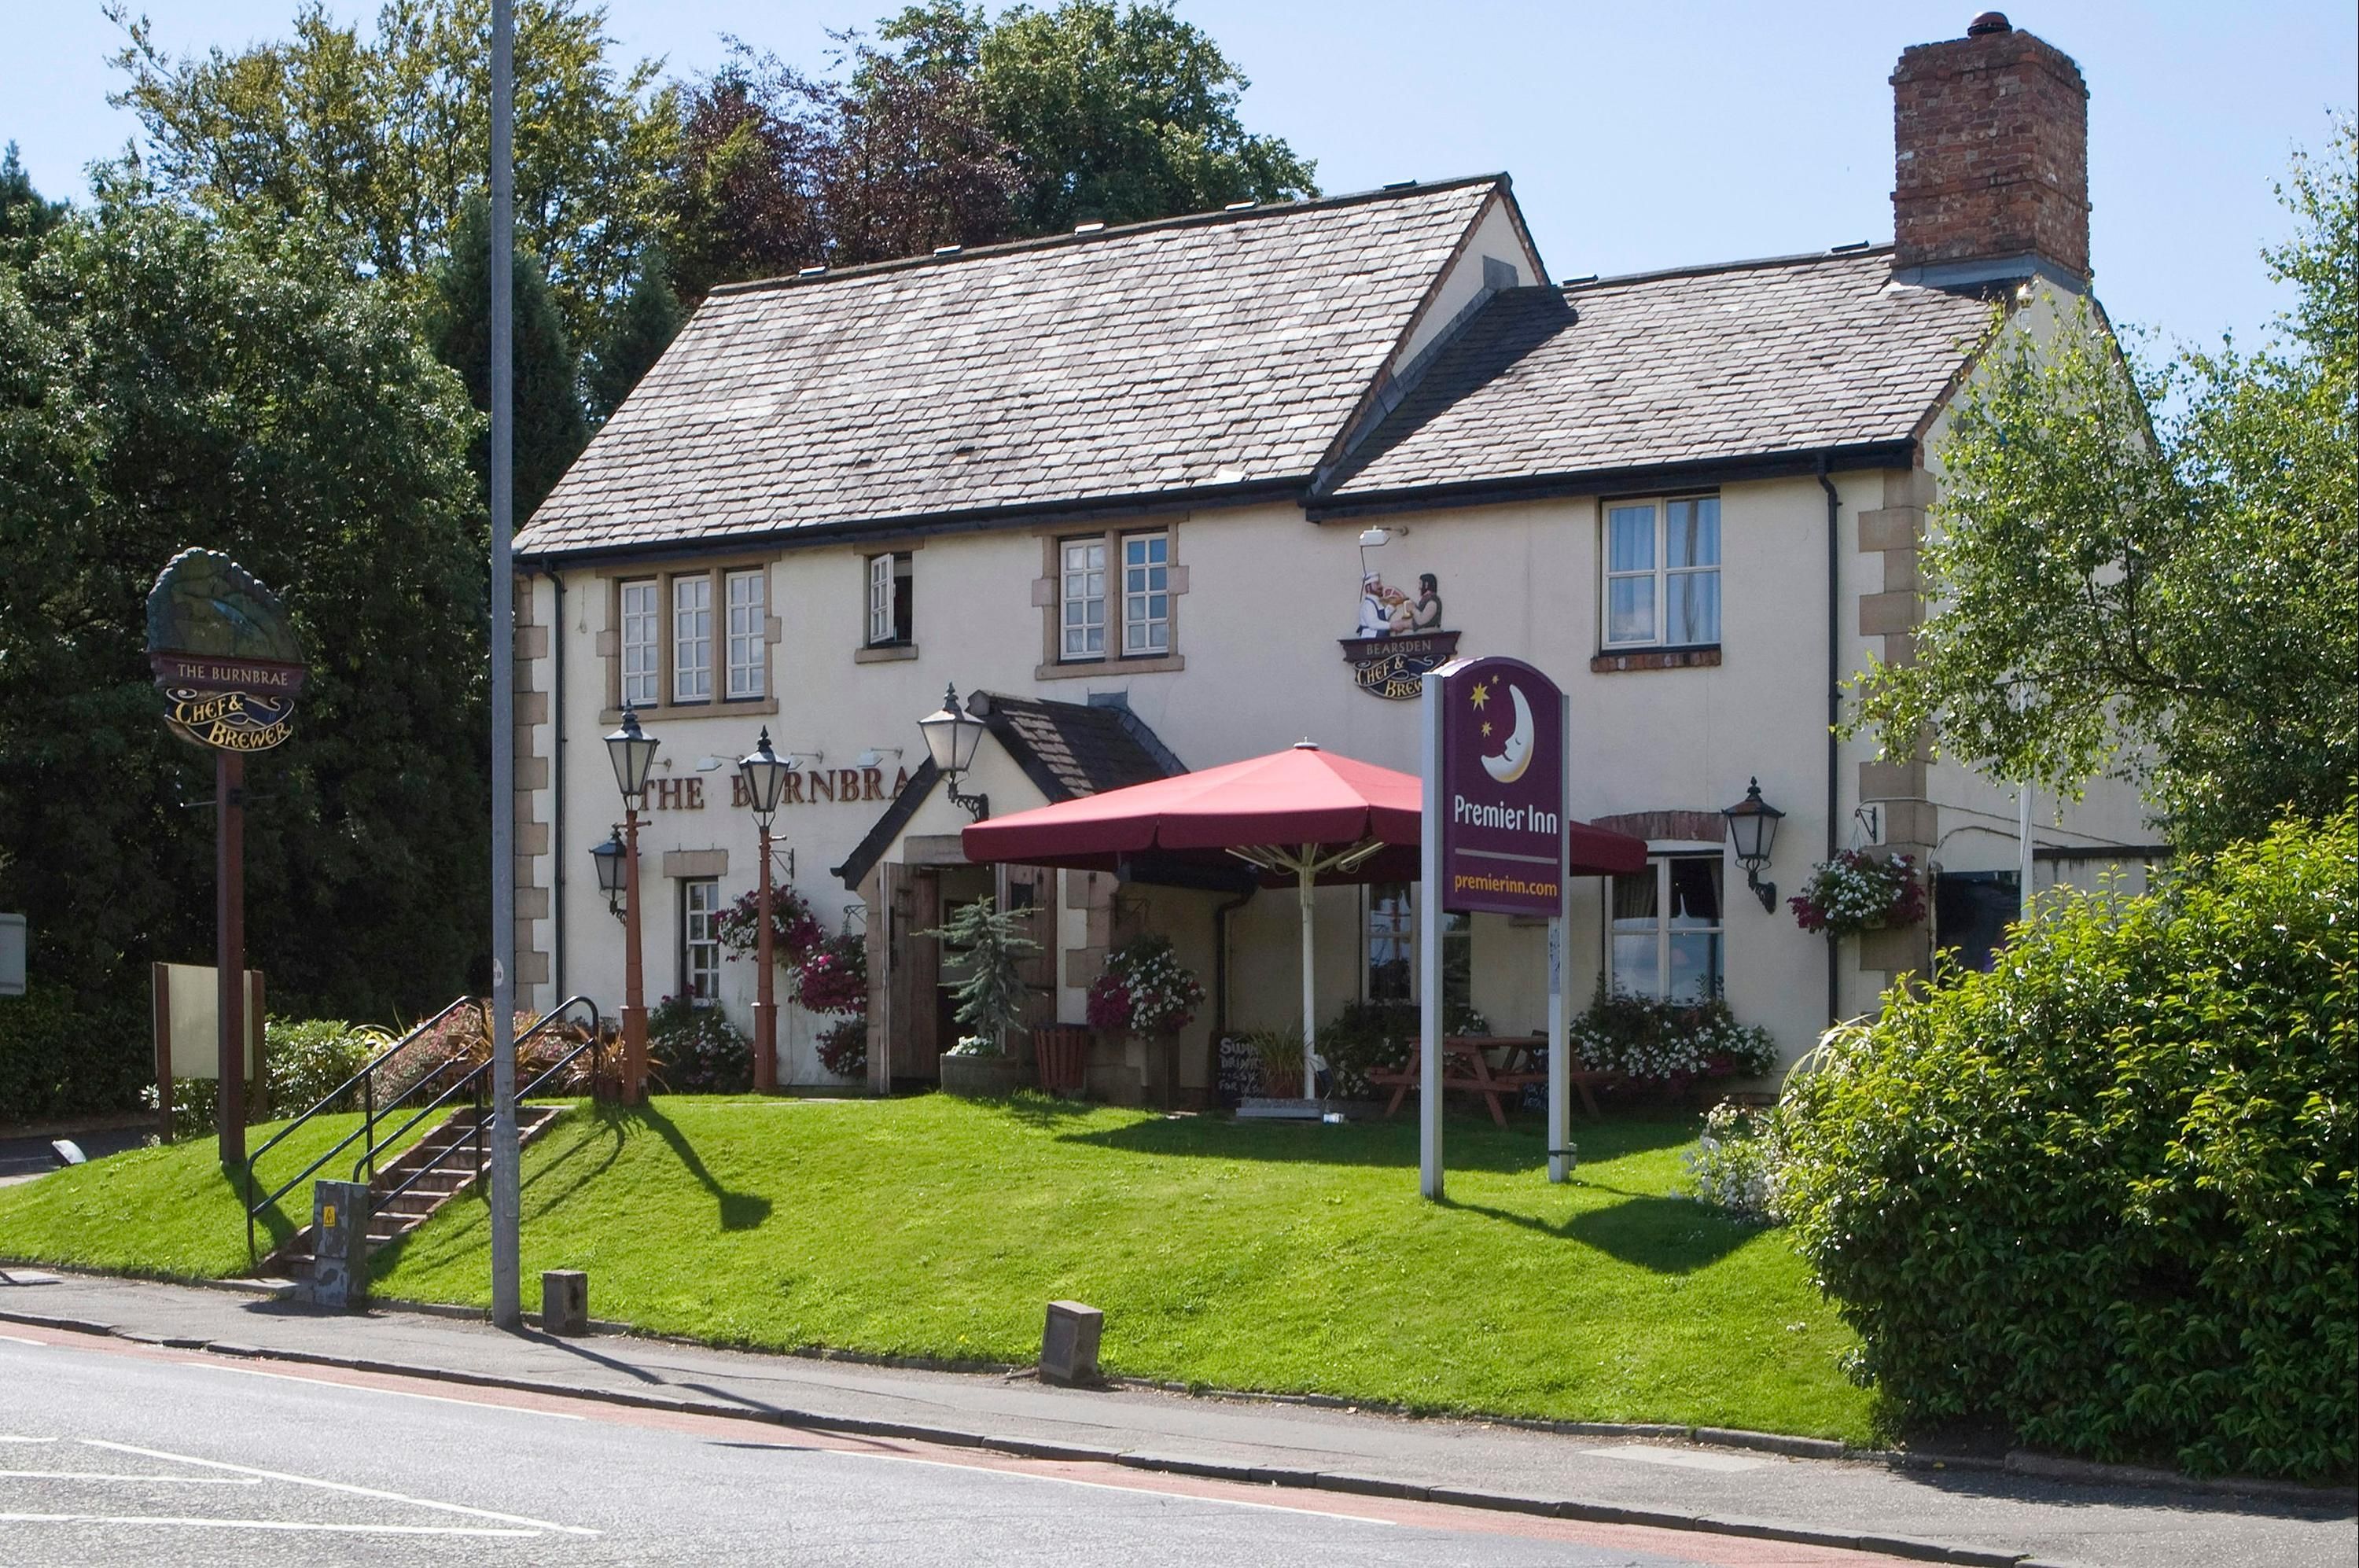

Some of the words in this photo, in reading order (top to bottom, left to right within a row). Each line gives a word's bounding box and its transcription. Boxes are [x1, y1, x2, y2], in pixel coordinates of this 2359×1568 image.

[1367, 640, 1431, 655] BEARSDEN
[178, 664, 205, 679] THE
[212, 667, 288, 686] BURNBRAE
[1357, 665, 1389, 684] CHEF
[1394, 656, 1404, 668] &
[1385, 679, 1422, 697] BREW
[175, 699, 225, 723] CHEF
[228, 694, 244, 711] &
[208, 721, 291, 748] BREWER
[639, 777, 705, 811] THE
[731, 766, 908, 807] BRNBRA
[1455, 794, 1525, 830] Premier
[1529, 804, 1557, 834] Inn
[1455, 873, 1557, 896] premierinn.com
